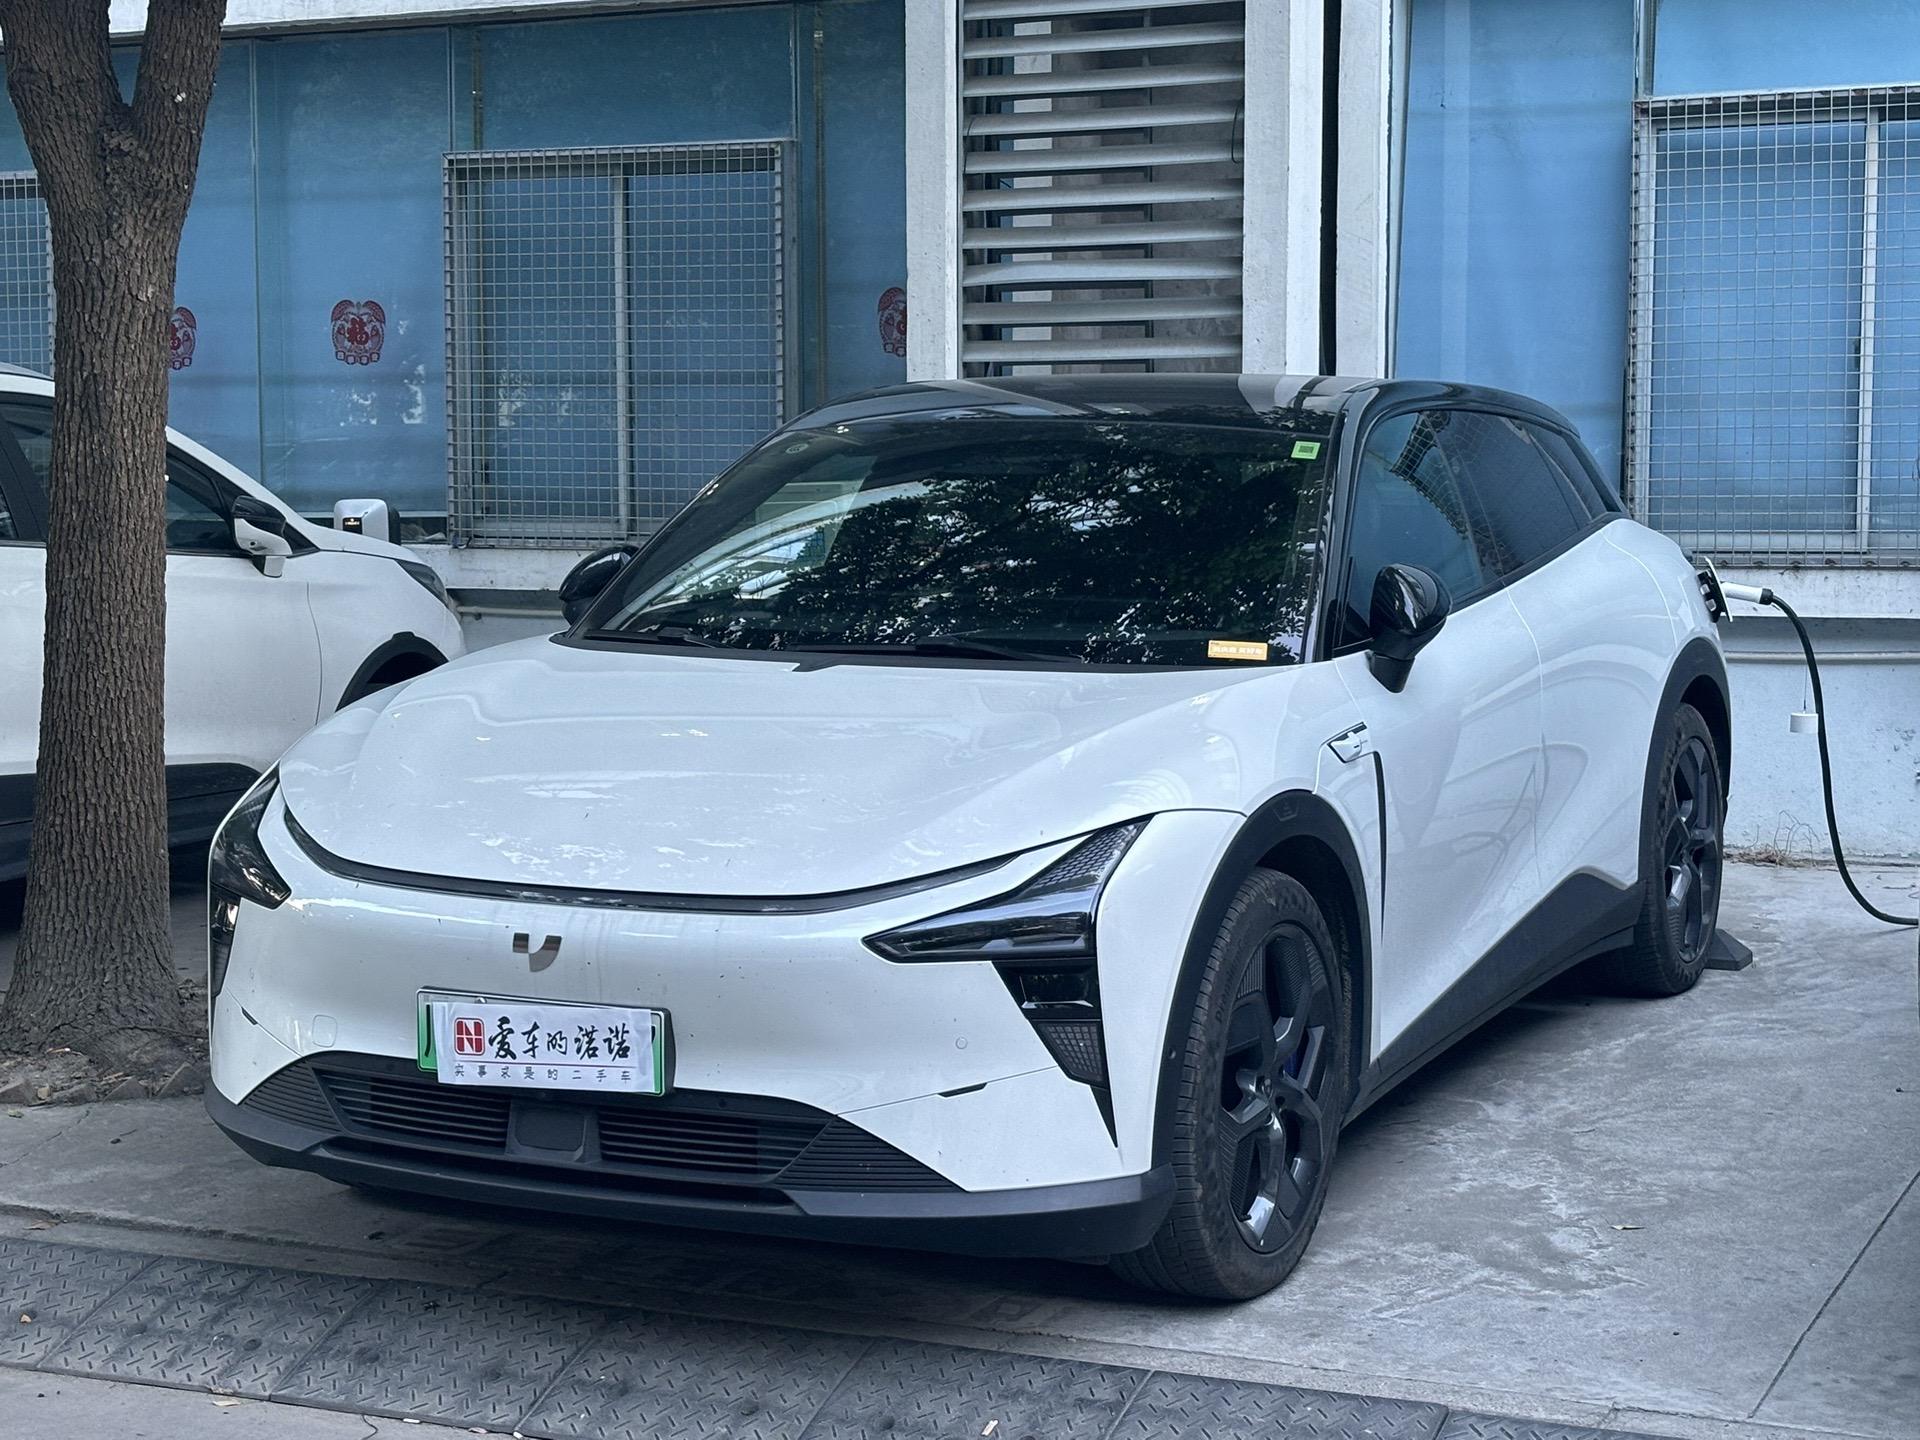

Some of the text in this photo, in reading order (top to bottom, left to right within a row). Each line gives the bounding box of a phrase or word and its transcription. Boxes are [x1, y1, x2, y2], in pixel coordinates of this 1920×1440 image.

[488, 1016, 631, 1062] 爱车的诺诺
[454, 1064, 632, 1084] 实事求是的二手车
